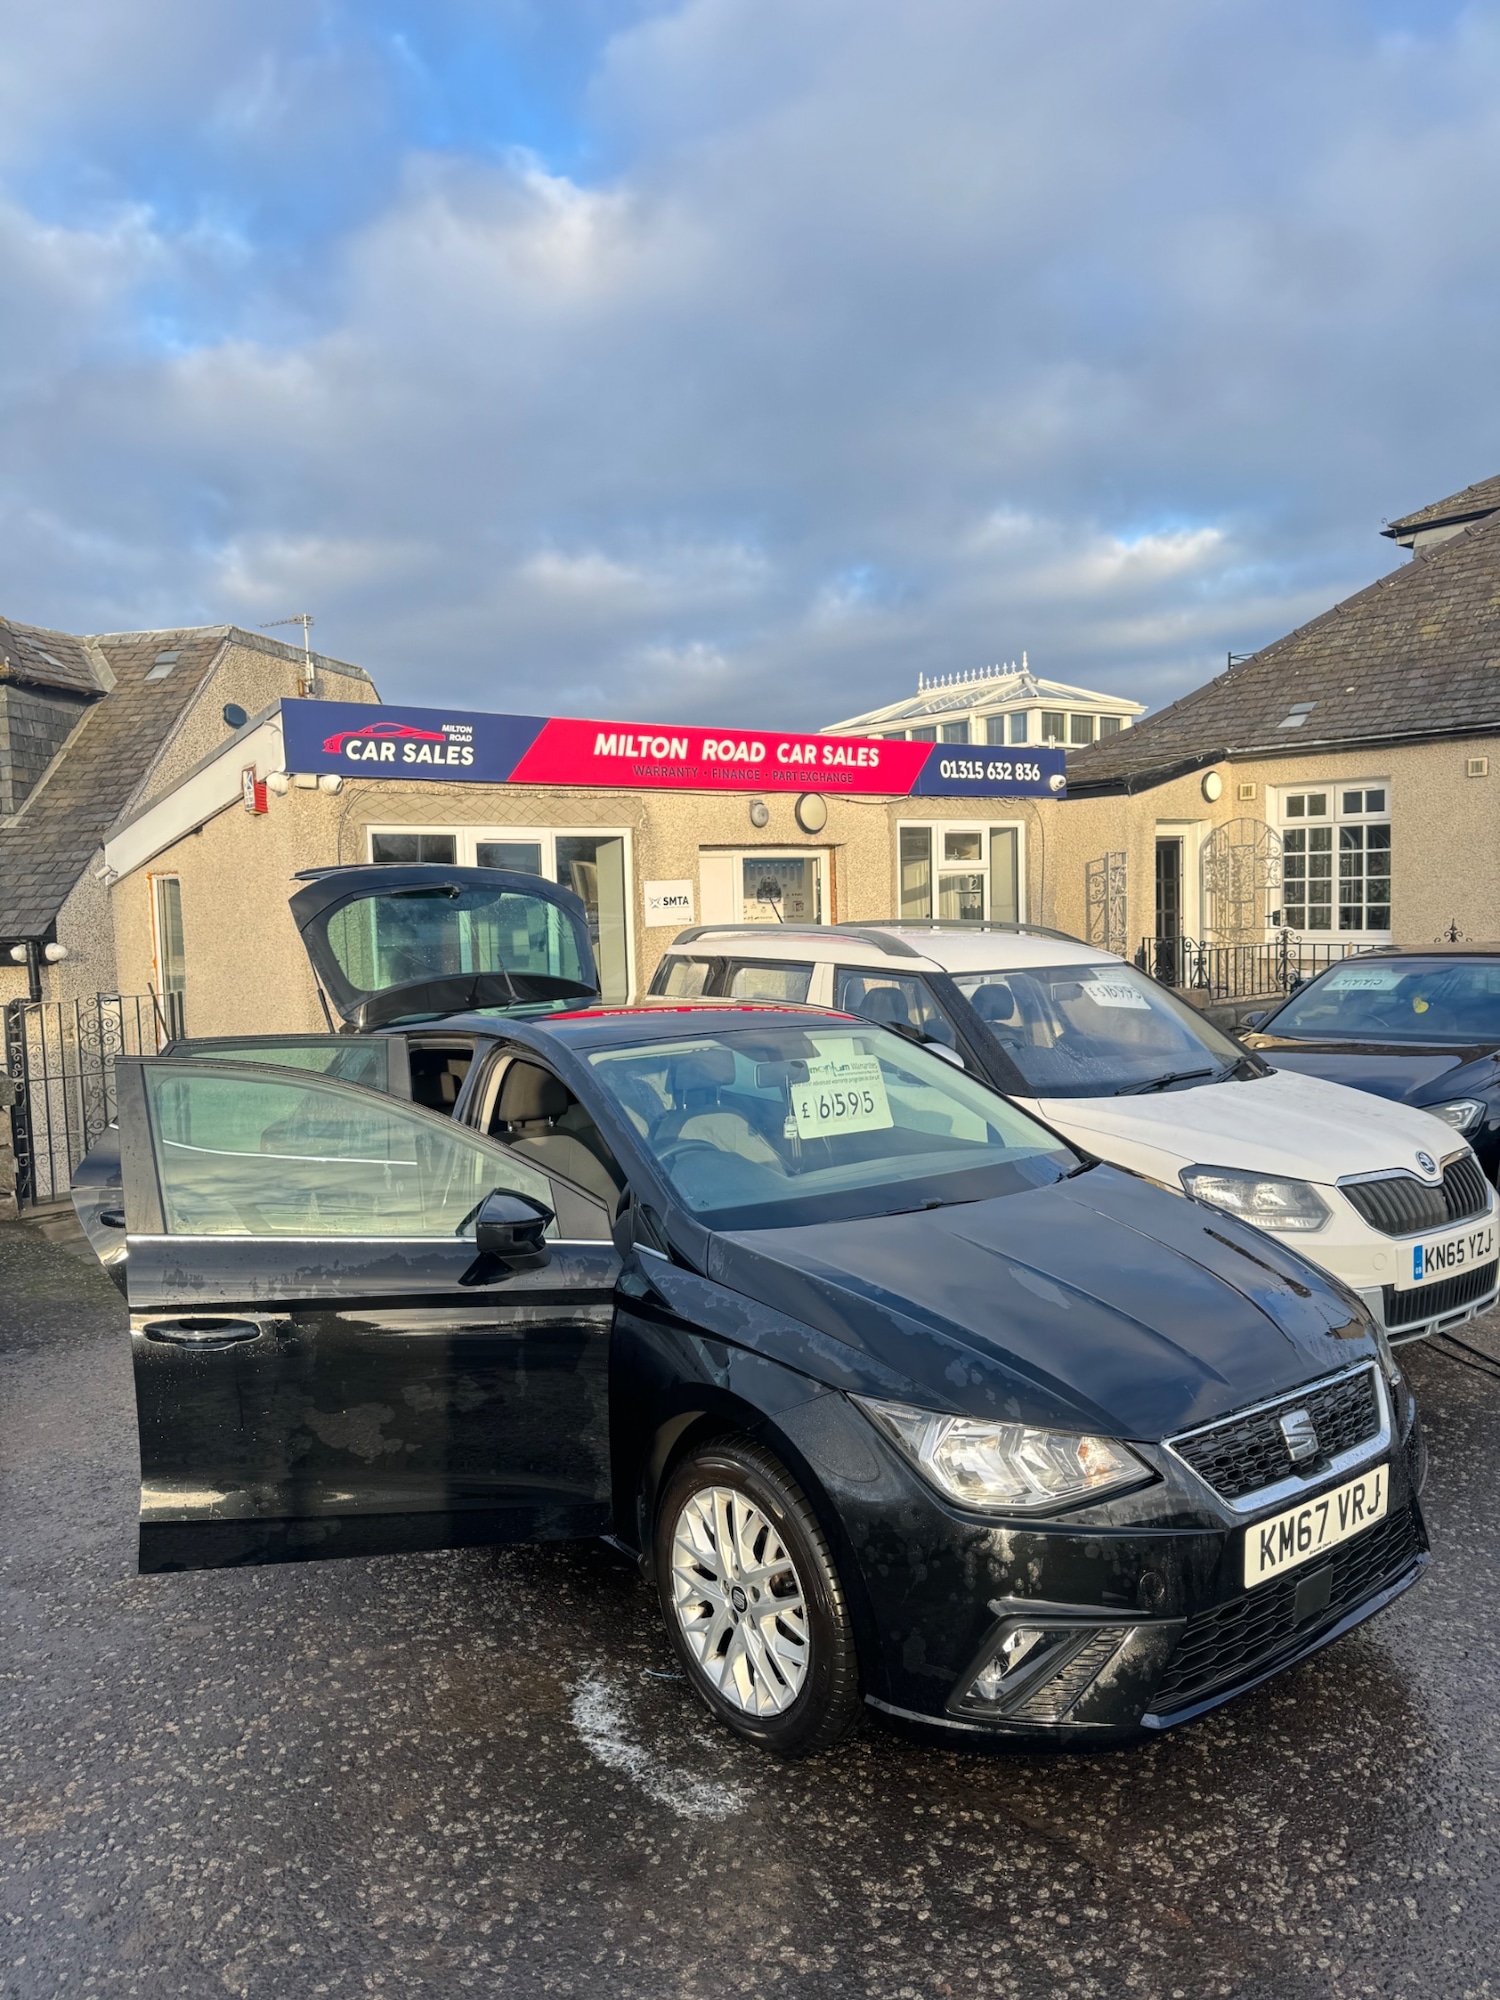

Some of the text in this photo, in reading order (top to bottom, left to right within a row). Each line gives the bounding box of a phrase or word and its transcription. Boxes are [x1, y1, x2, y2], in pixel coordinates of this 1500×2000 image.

[441, 724, 473, 734] MILTON
[448, 733, 473, 743] ROAD
[345, 740, 475, 766] CAR SALES
[593, 733, 879, 767] MILTON ROAD CAR SALES
[633, 765, 853, 783] WARRANTY FINANCE PART EXCHANGE
[939, 759, 1041, 782] 01315 632 836
[663, 895, 689, 906] SMTA
[819, 1091, 874, 1119] 6595
[1425, 1228, 1494, 1273] KN65 YZJ
[1260, 1473, 1381, 1571] KM67 VRJ
